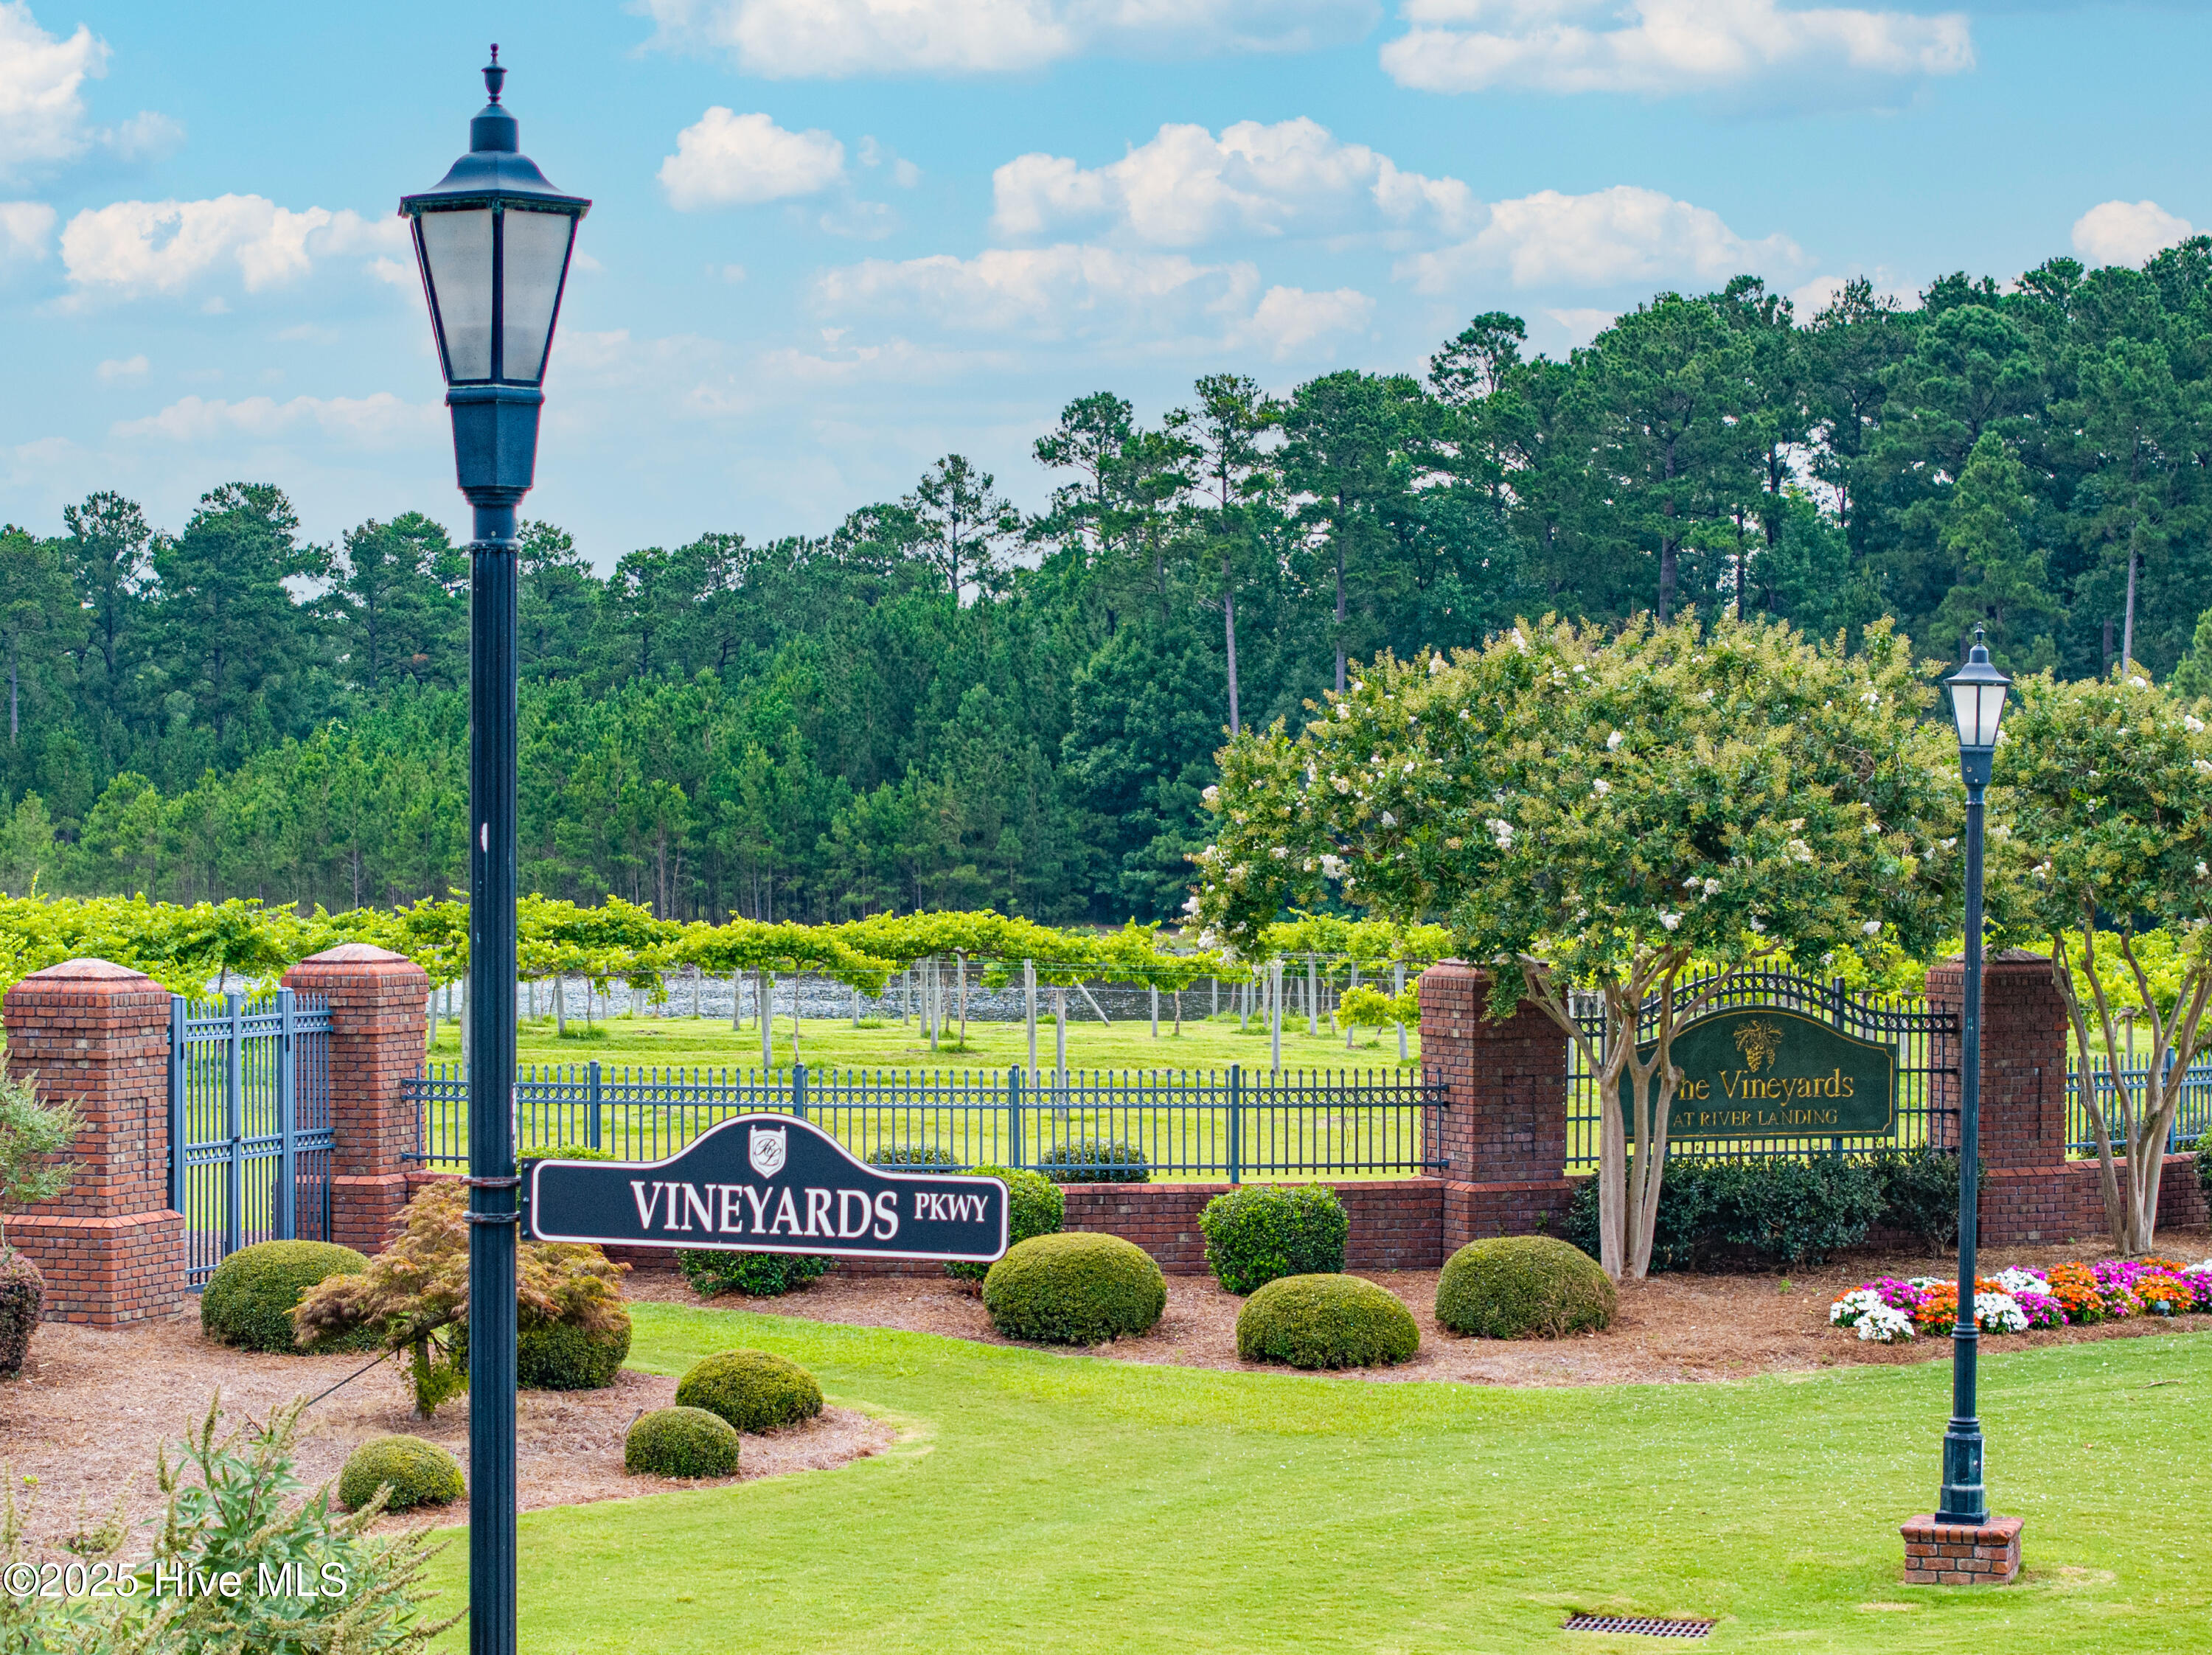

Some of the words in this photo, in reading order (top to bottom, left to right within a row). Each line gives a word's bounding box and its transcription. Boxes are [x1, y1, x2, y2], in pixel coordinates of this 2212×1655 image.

[1658, 1070, 1710, 1101] he
[1719, 1067, 1854, 1107] Vineyards
[1673, 1111, 1695, 1127] AT
[1700, 1110, 1752, 1126] RIVER
[1757, 1109, 1839, 1126] LANDING
[630, 1180, 900, 1241] VINEYARDS
[914, 1191, 989, 1224] PKWY
